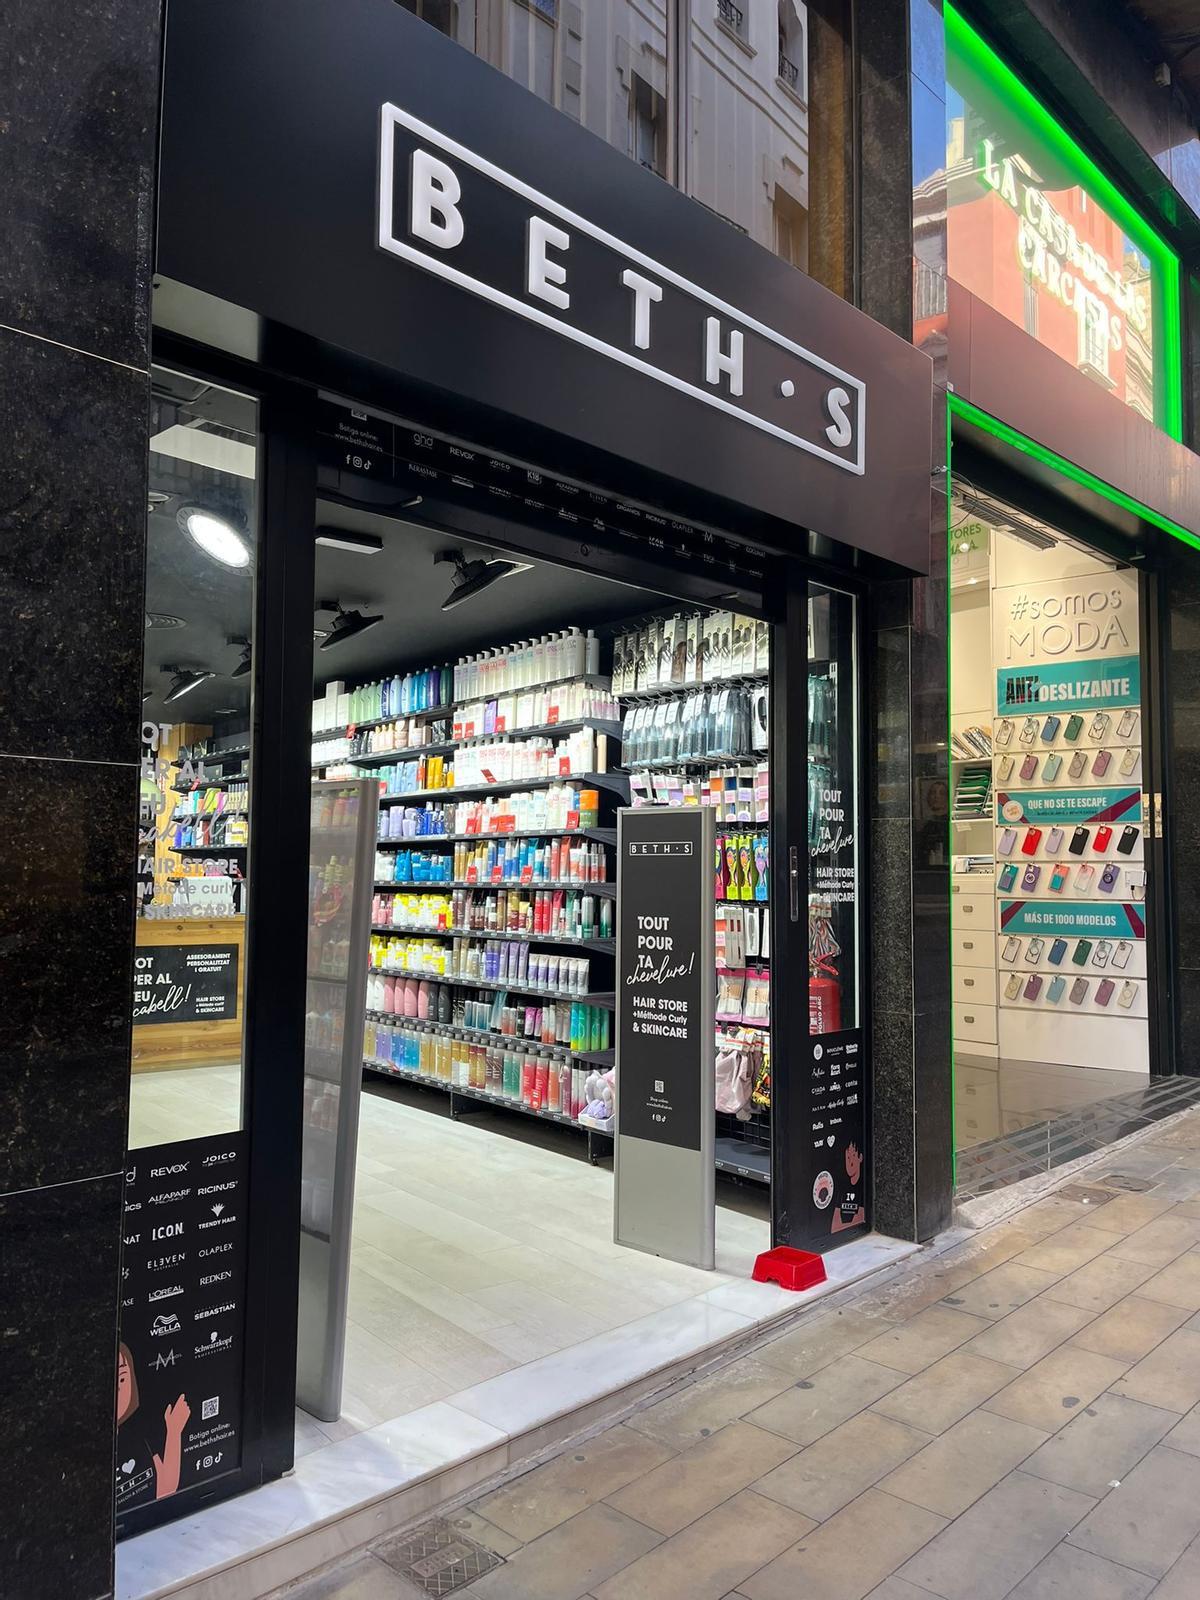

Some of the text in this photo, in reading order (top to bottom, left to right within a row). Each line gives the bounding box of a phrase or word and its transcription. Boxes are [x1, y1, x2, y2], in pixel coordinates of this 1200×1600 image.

[1006, 614, 1130, 660] MODA
[178, 759, 209, 783] AL
[820, 789, 842, 803] TOUT
[1027, 797, 1108, 810] QUE NO SE TE ESCAPE
[820, 808, 845, 821] POUR
[820, 826, 831, 839] TA
[182, 857, 239, 874] STORE
[816, 867, 855, 878] HAIR STORE
[201, 881, 238, 899] curly
[637, 916, 669, 931] TOUT
[1024, 912, 1117, 927] MÁS DE 1000 MODELOS
[637, 935, 673, 950] POUR
[638, 954, 654, 968] TA
[155, 973, 172, 985] AL
[132, 983, 192, 1017] cabell!
[632, 996, 688, 1012] HAIR STORE
[668, 1013, 688, 1025] Curly
[632, 1022, 688, 1039] & SKINCARE
[202, 1152, 236, 1164] JOICO
[150, 1161, 190, 1178] REVOX
[148, 1188, 191, 1204] ALFAPARF
[198, 1215, 236, 1230] TRENDY HAIR
[198, 1242, 233, 1258] OLAPLEX
[199, 1270, 232, 1286] REDKEN
[194, 1303, 236, 1320] SEBASTIAN
[150, 1322, 181, 1337] WELLA
[194, 1335, 233, 1354] Schwarzkopf
[183, 1430, 236, 1453] www.bethshair.es
[189, 1429, 210, 1442] Botiga
